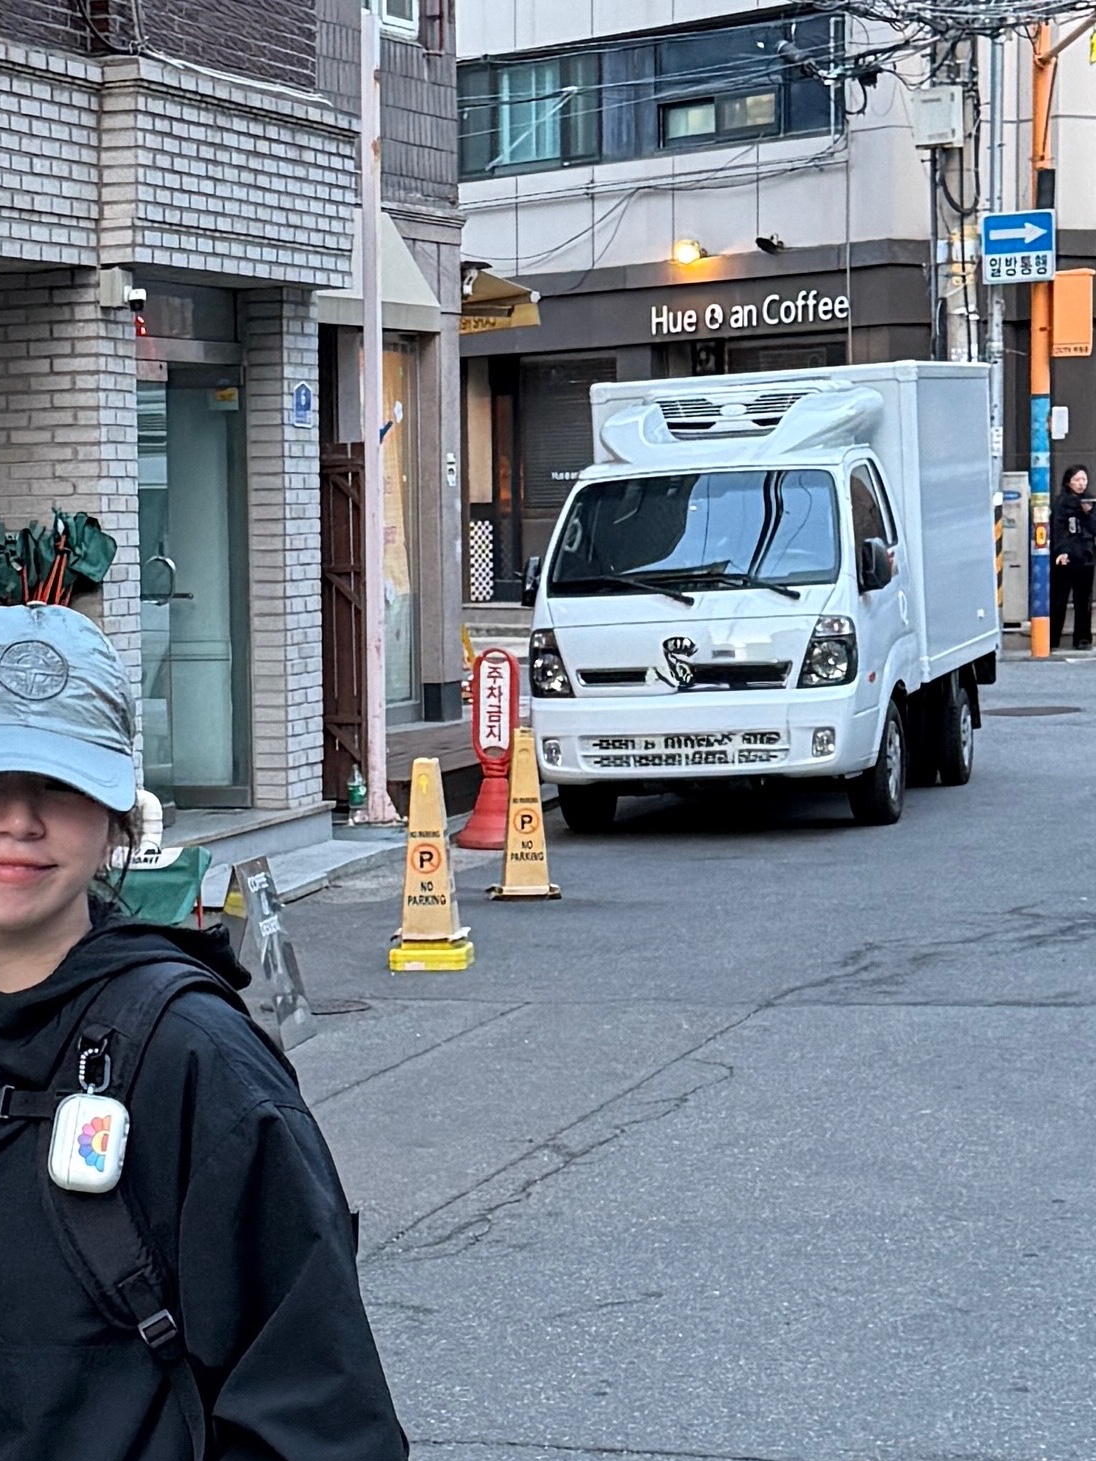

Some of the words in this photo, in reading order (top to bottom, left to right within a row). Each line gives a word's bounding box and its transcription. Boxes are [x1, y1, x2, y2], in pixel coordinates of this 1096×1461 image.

[989, 254, 1048, 278] 일방통행
[651, 305, 697, 335] Hue
[730, 304, 757, 328] an
[762, 290, 850, 325] Coffee
[486, 665, 504, 742] 주차금지
[521, 840, 534, 850] NO
[419, 850, 434, 868] P
[511, 851, 545, 862] PARKING
[420, 881, 434, 893] NO
[407, 894, 447, 907] PARKING
